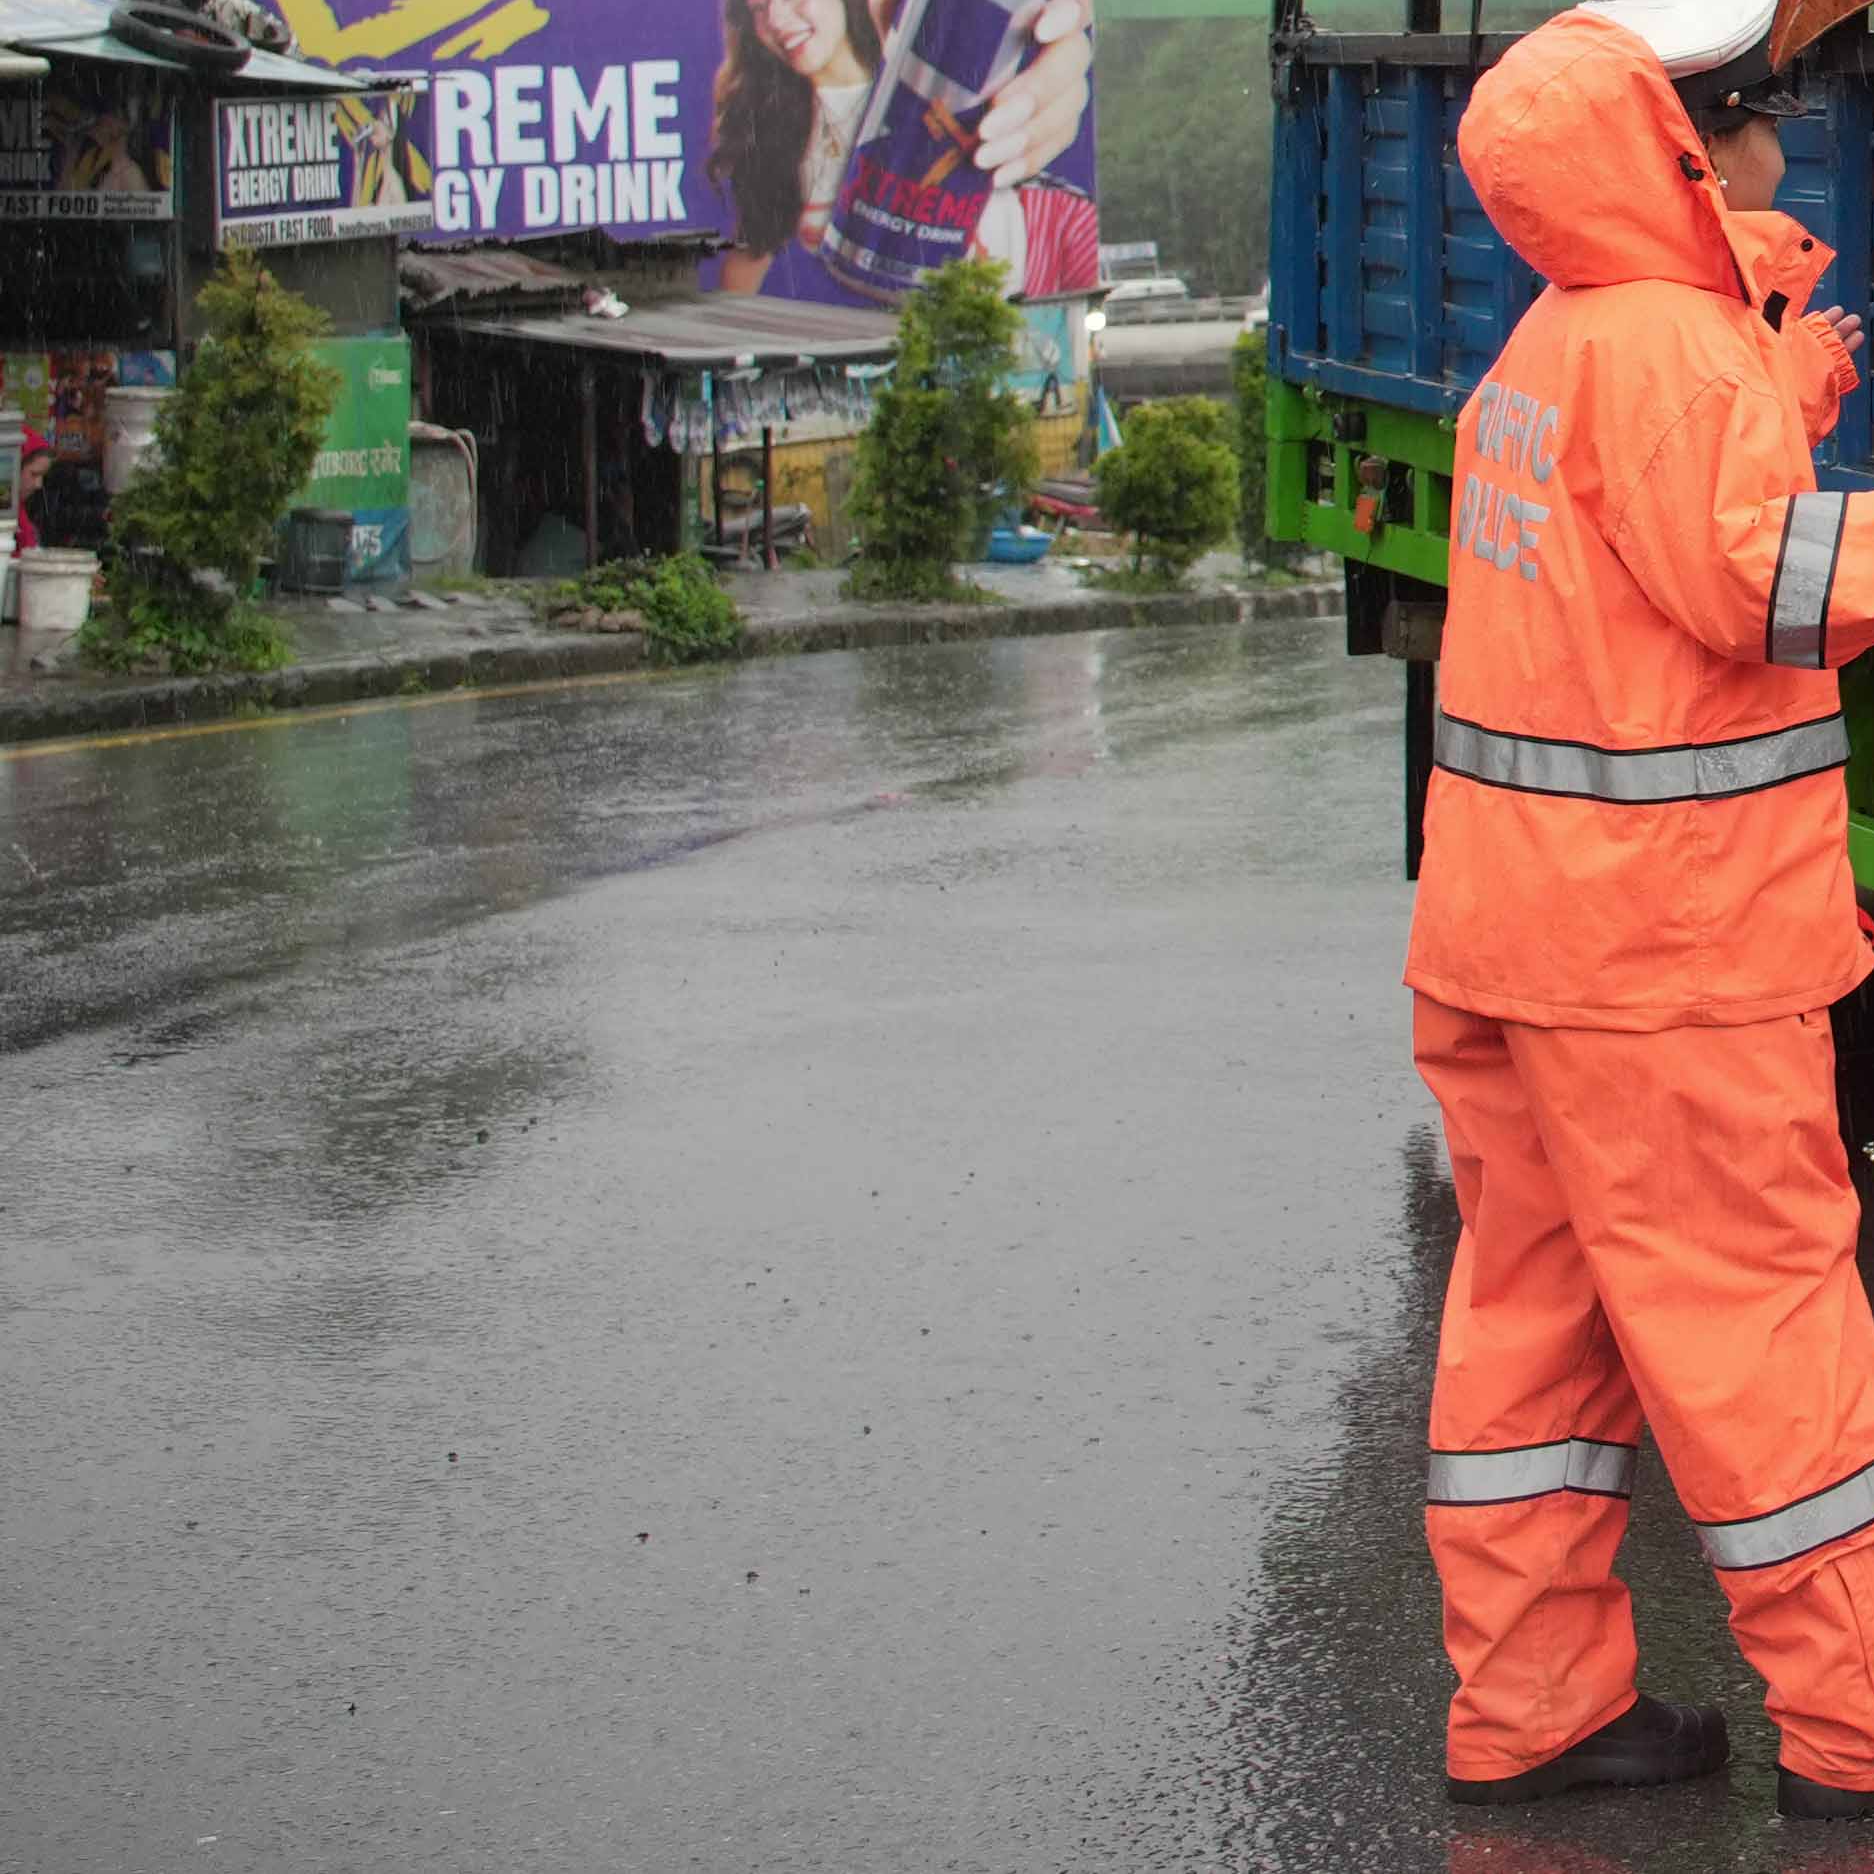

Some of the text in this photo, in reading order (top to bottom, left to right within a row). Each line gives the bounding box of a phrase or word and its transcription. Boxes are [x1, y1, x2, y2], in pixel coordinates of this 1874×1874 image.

[227, 101, 340, 169] XTREME
[434, 59, 683, 169] REME
[49, 194, 99, 215] FOOD
[229, 163, 341, 208] ENERGY DRINK
[521, 159, 687, 228] DRINK
[279, 218, 304, 240] FAST
[1457, 474, 1551, 583] OLICE
